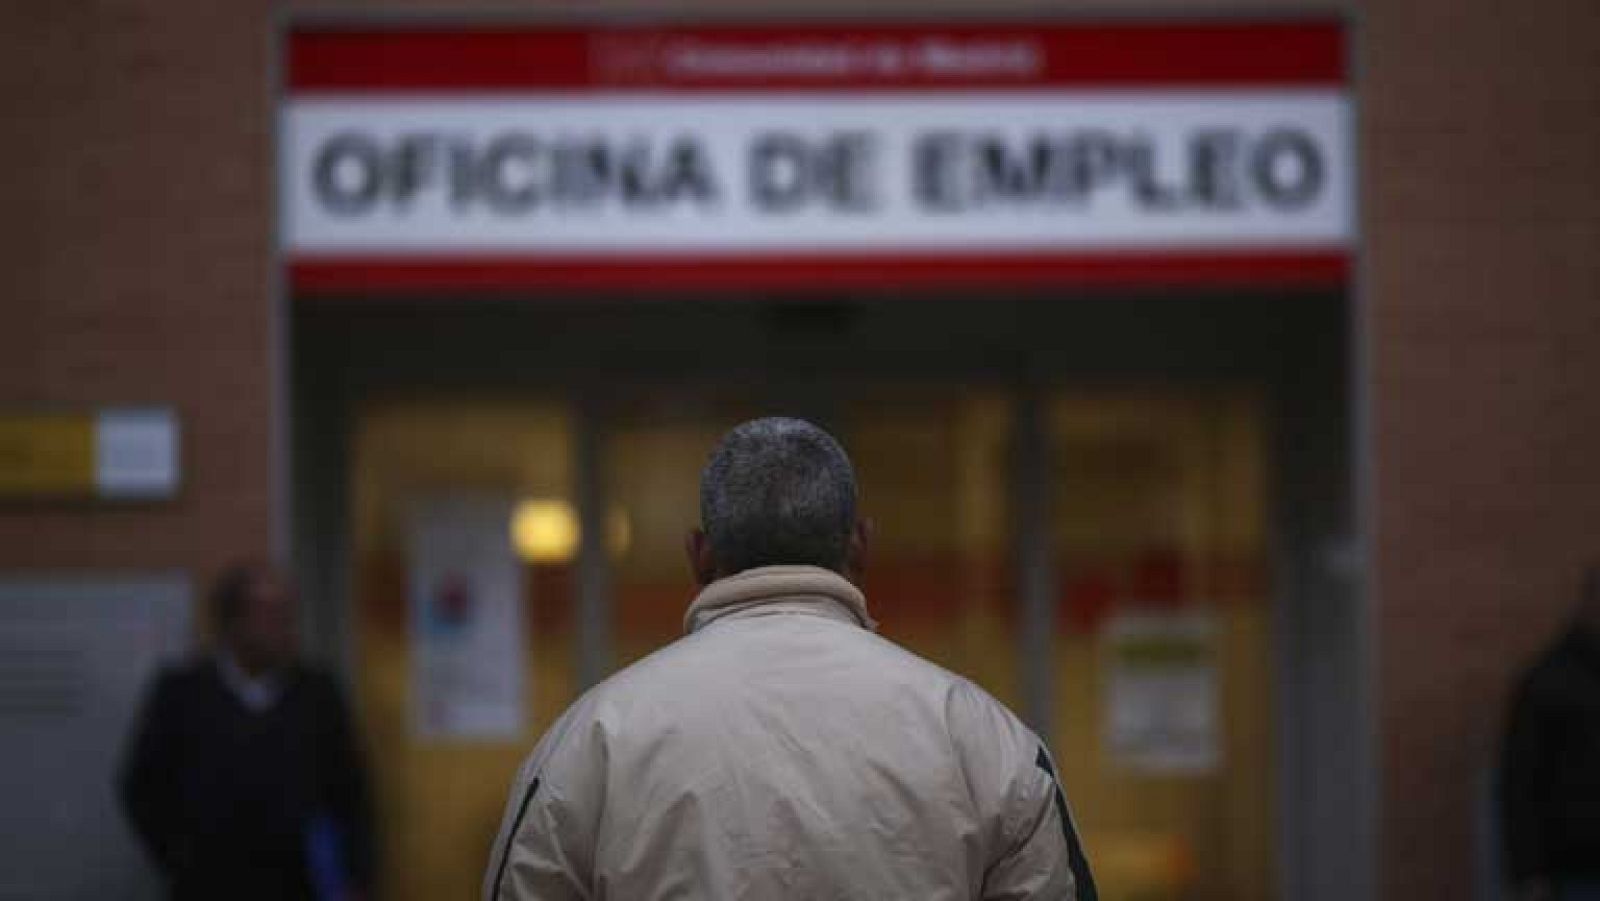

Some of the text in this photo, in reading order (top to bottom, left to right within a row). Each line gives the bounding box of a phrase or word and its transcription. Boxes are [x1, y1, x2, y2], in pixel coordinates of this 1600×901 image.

[312, 128, 1326, 213] OFICINA DE EMPLEO
